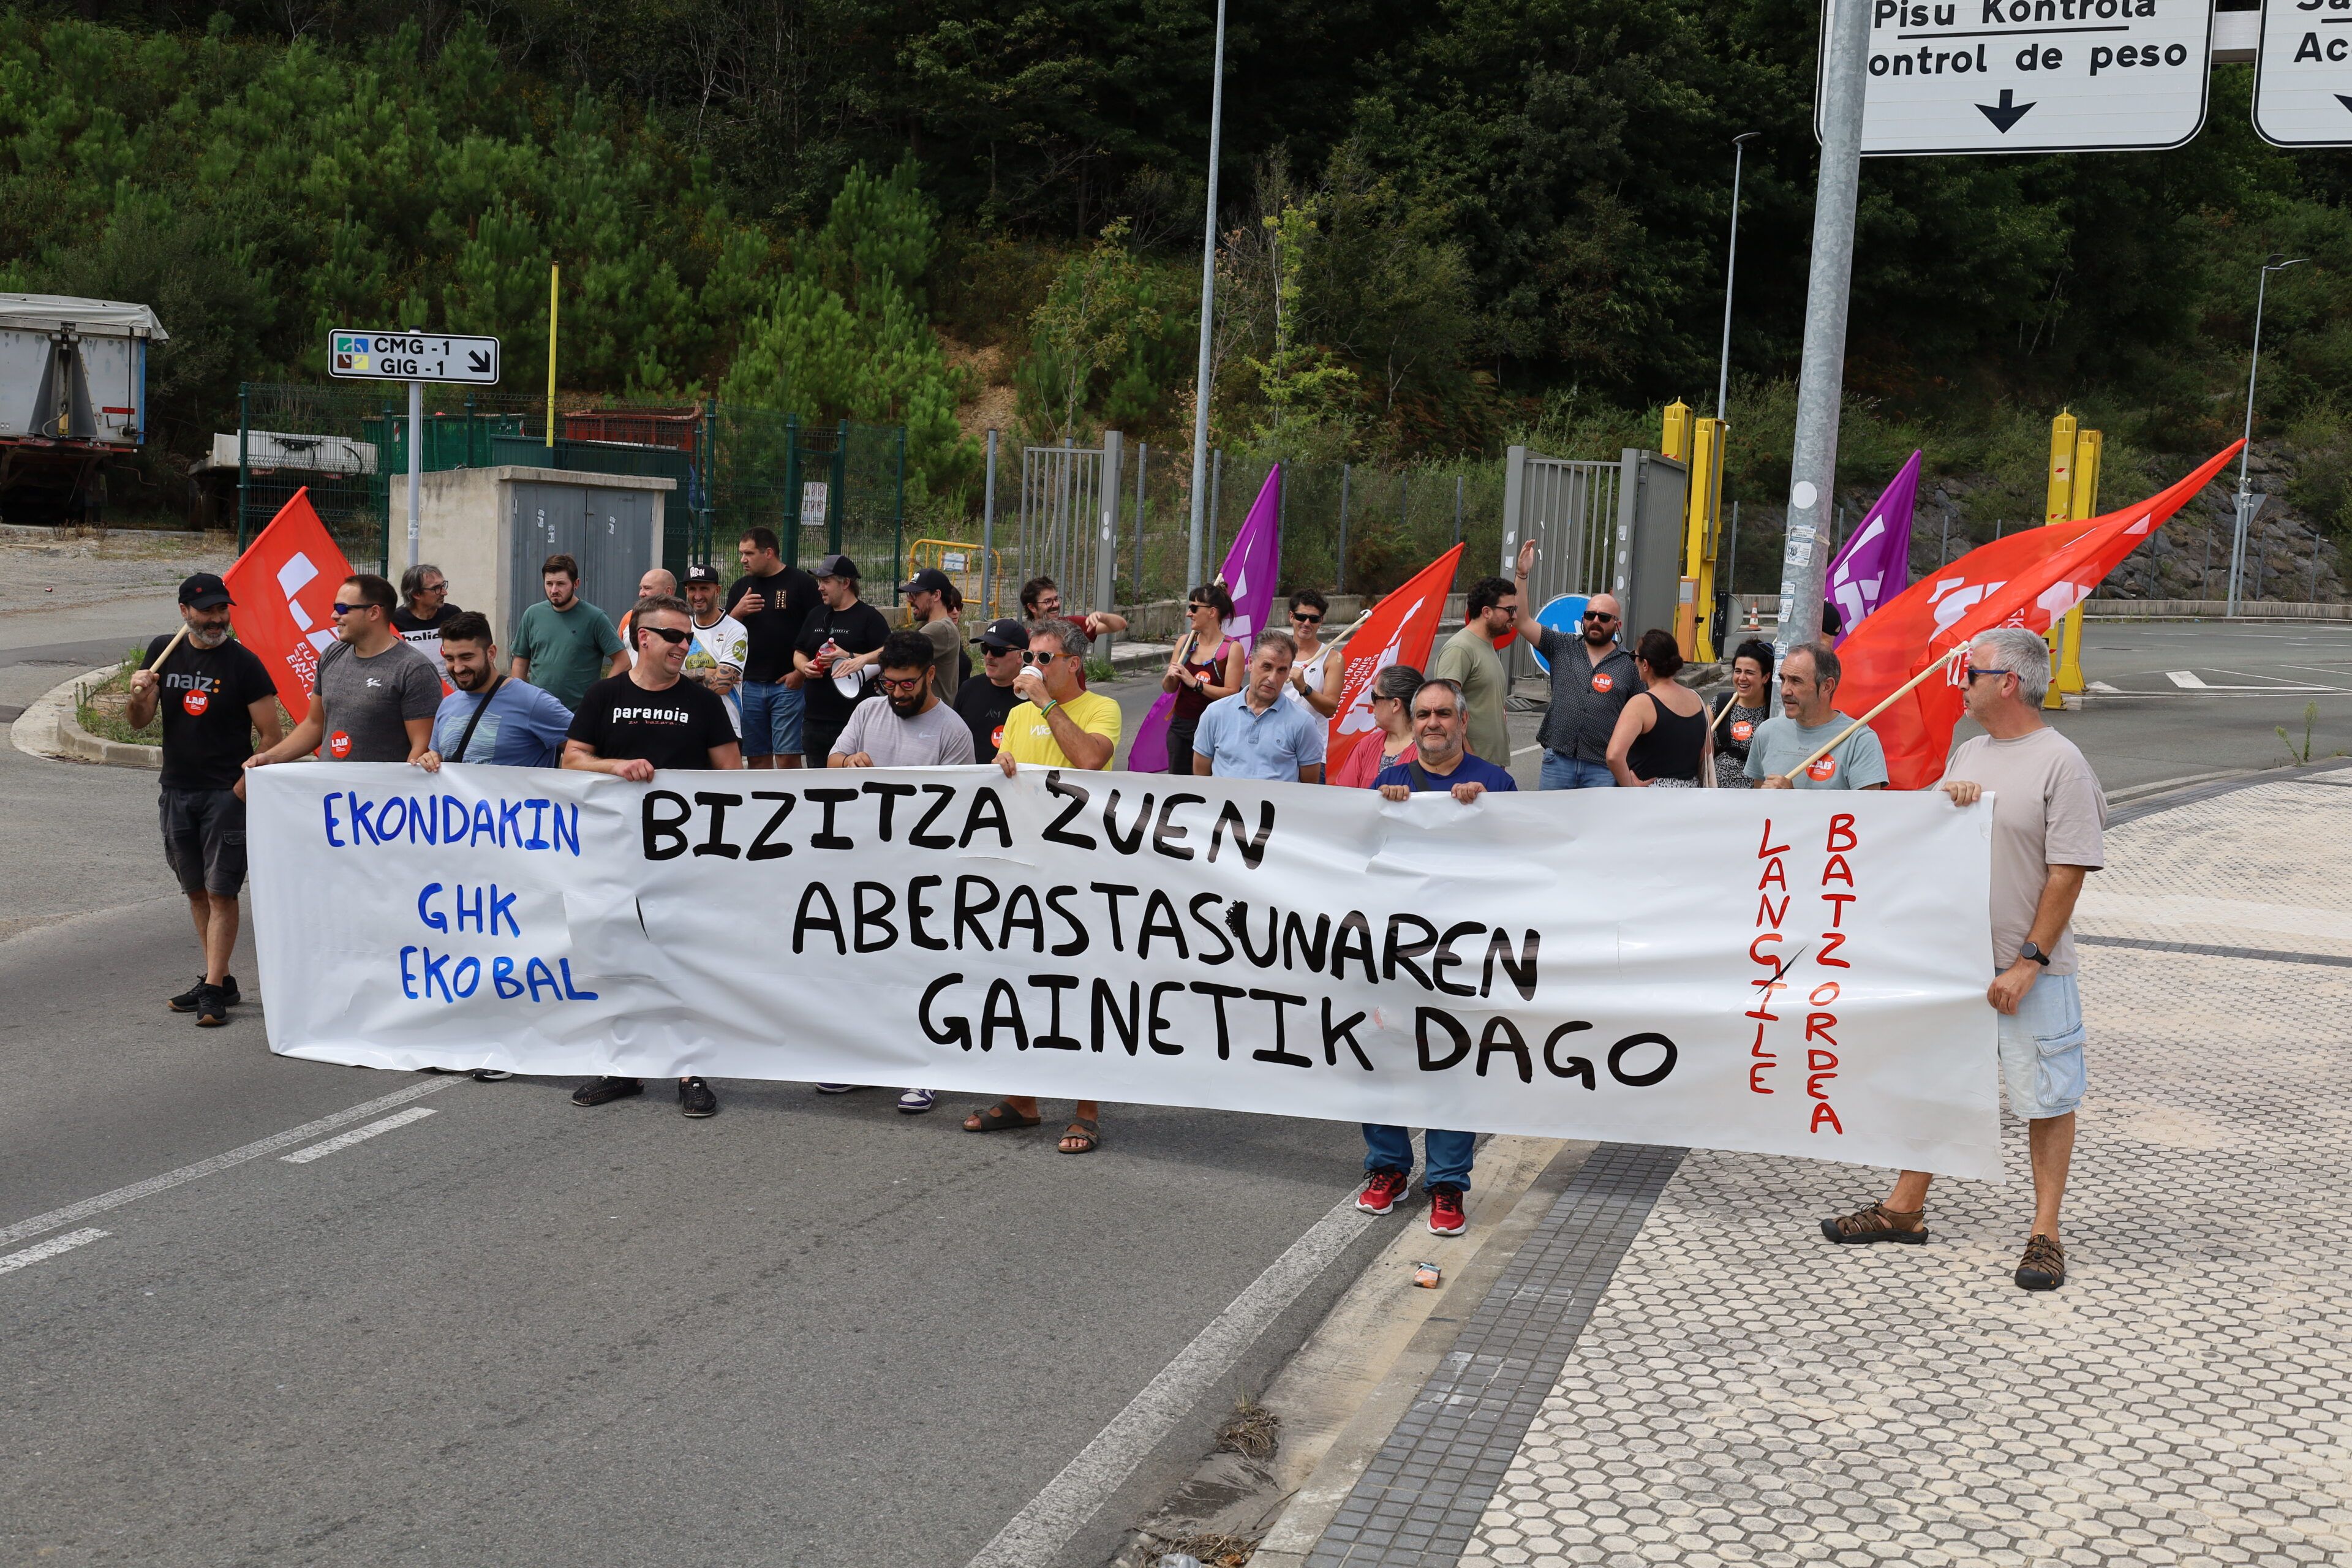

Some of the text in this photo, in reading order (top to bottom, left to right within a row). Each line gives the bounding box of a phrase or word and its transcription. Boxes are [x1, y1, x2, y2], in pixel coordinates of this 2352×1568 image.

[1874, 0, 2156, 28] Pisu Kontrola
[1868, 43, 2187, 76] ontrol de peso
[2293, 32, 2352, 62] Ac
[374, 337, 423, 354] CMG
[442, 341, 450, 355] 1
[380, 358, 417, 374] GIG
[437, 361, 443, 375] 1
[186, 696, 206, 705] LAB
[612, 707, 688, 723] paranoia
[332, 737, 349, 747] LAB
[323, 791, 581, 857] EKONDAKIN
[642, 770, 1275, 869] BIZITZA ZUEN
[418, 883, 520, 938] GHK
[793, 875, 1540, 1001] ABERASTASUNAREN
[1746, 819, 1790, 1094] LANGILE
[400, 946, 598, 1004] EKOBAL
[1806, 813, 1857, 1134] BATZORDEA
[919, 973, 1678, 1091] GAINETIK DAGO
